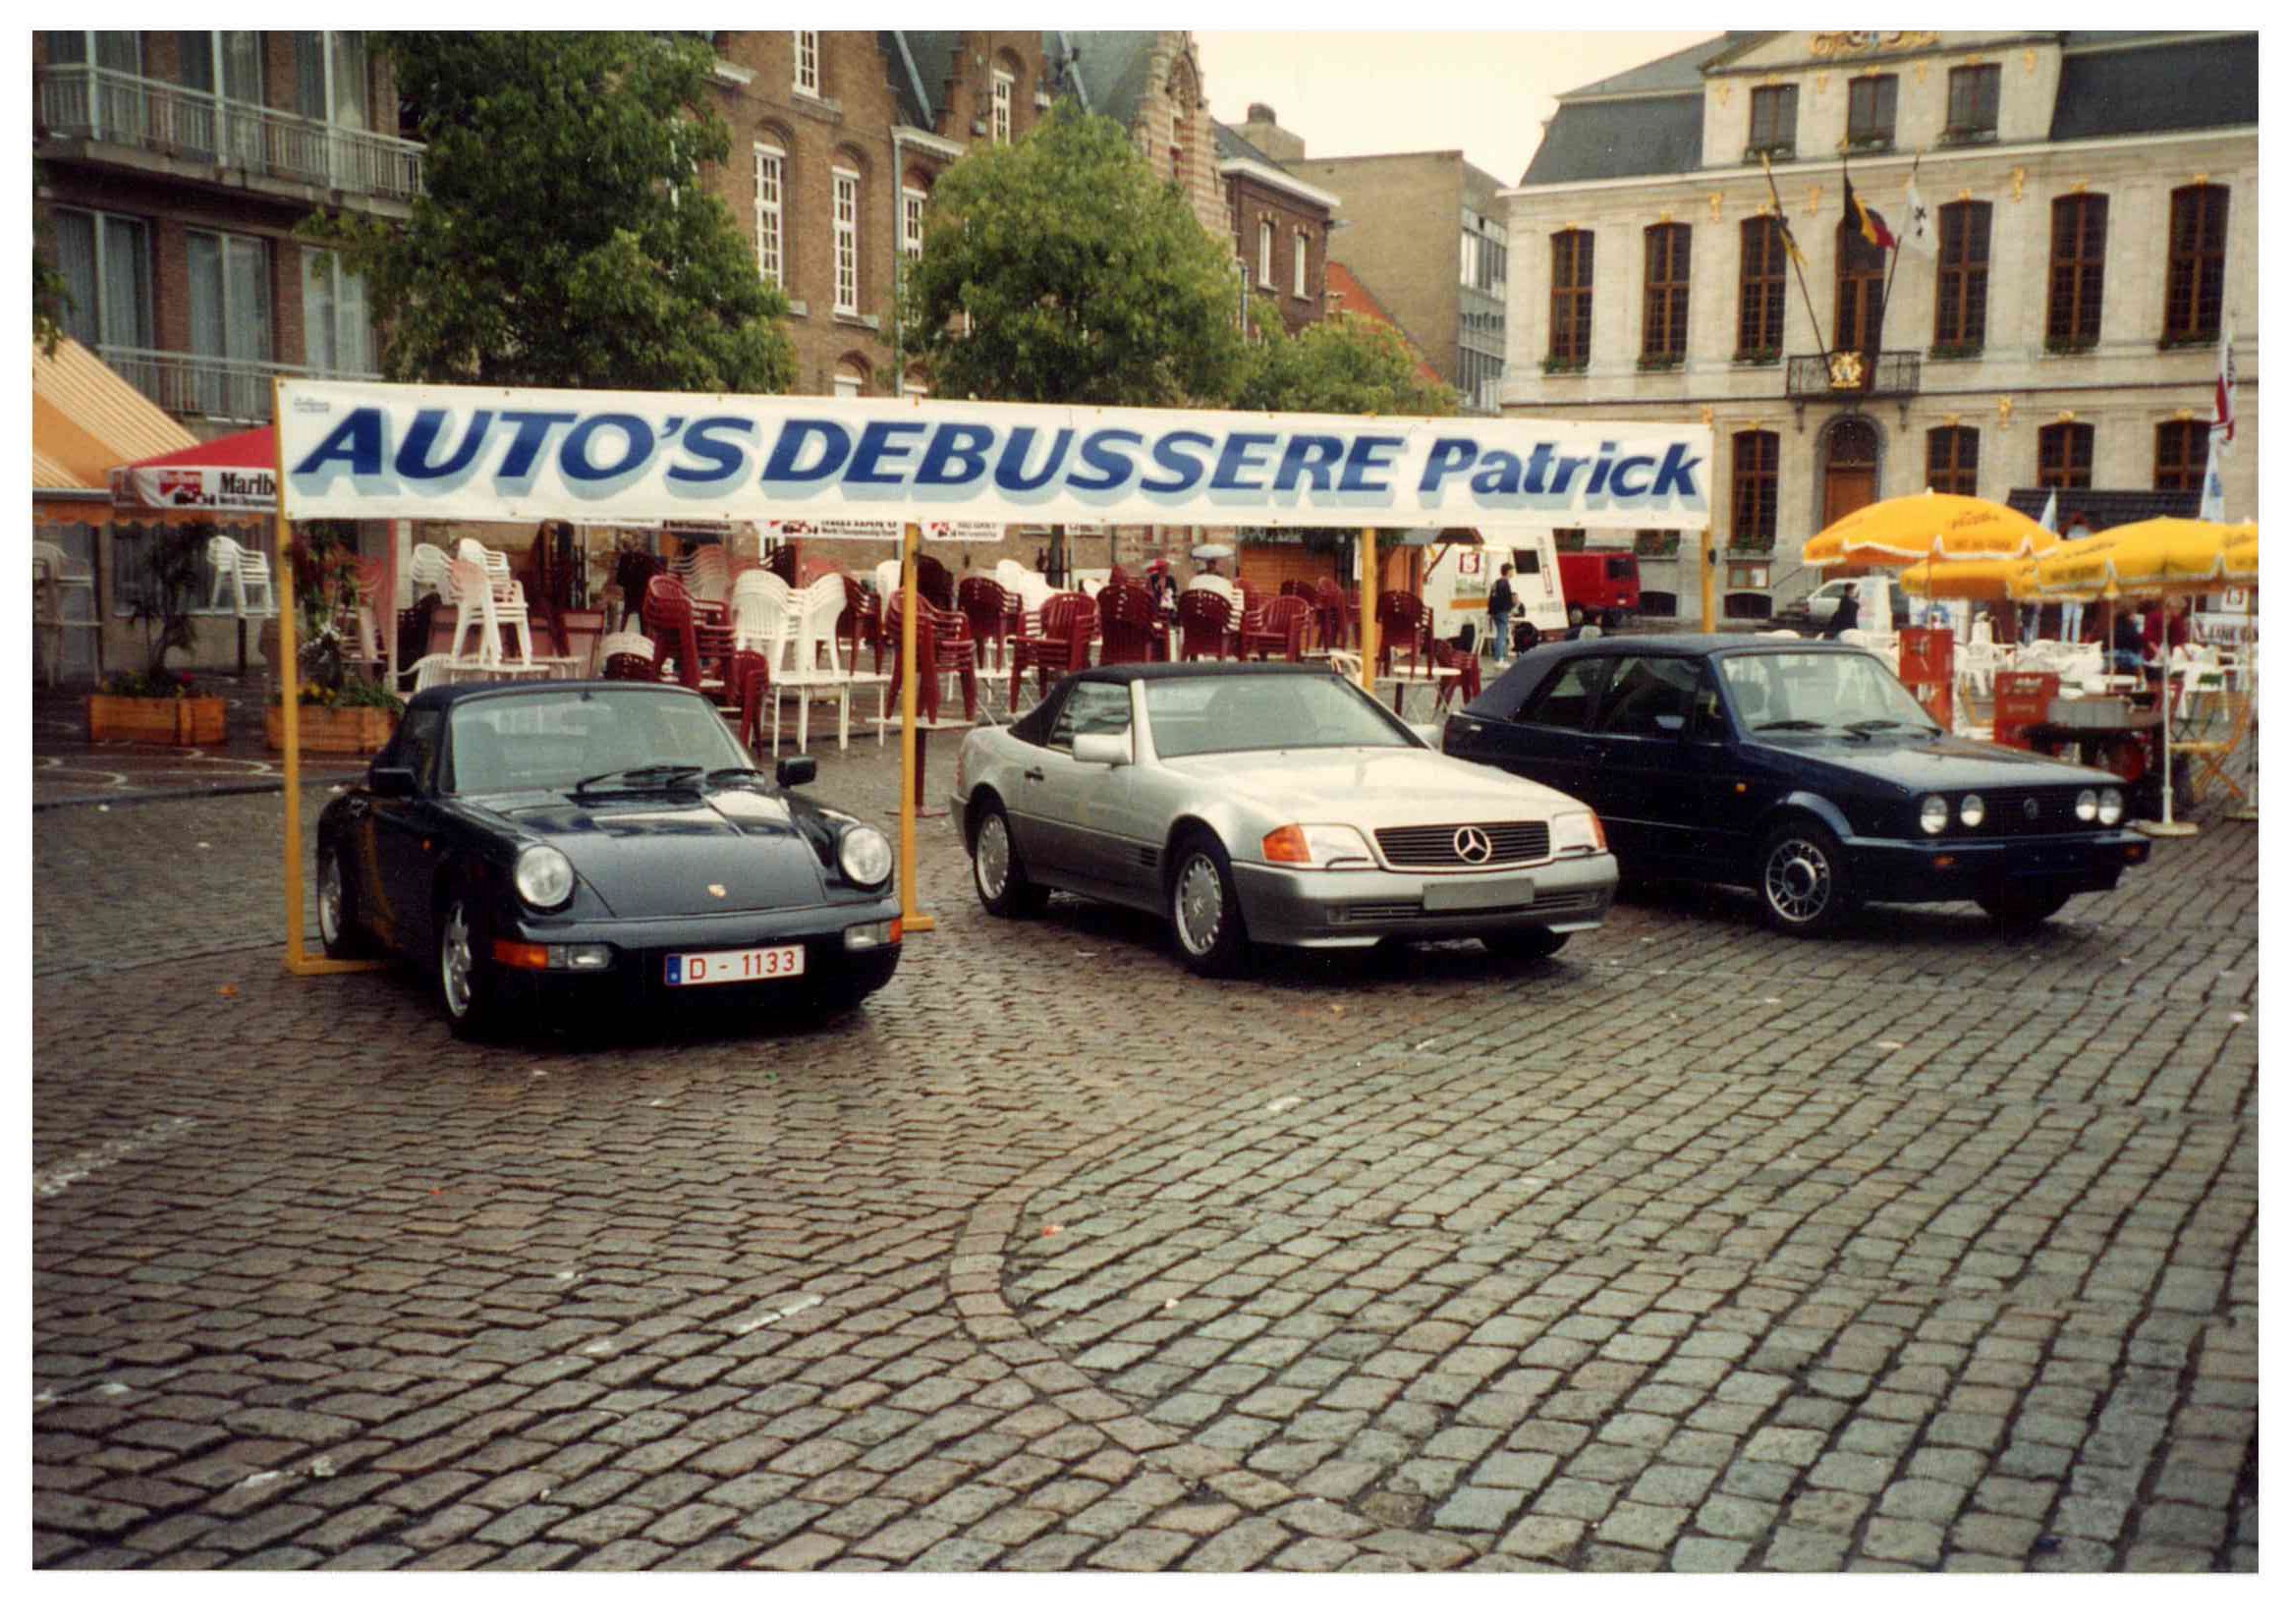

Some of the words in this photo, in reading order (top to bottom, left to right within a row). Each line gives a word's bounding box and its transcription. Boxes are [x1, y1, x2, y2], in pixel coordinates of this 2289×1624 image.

[292, 407, 754, 482] AUTO'S
[762, 420, 1405, 494] DEBUSSERE
[1419, 437, 1702, 498] Patrick
[689, 958, 706, 980] D
[741, 950, 797, 976] 1133
